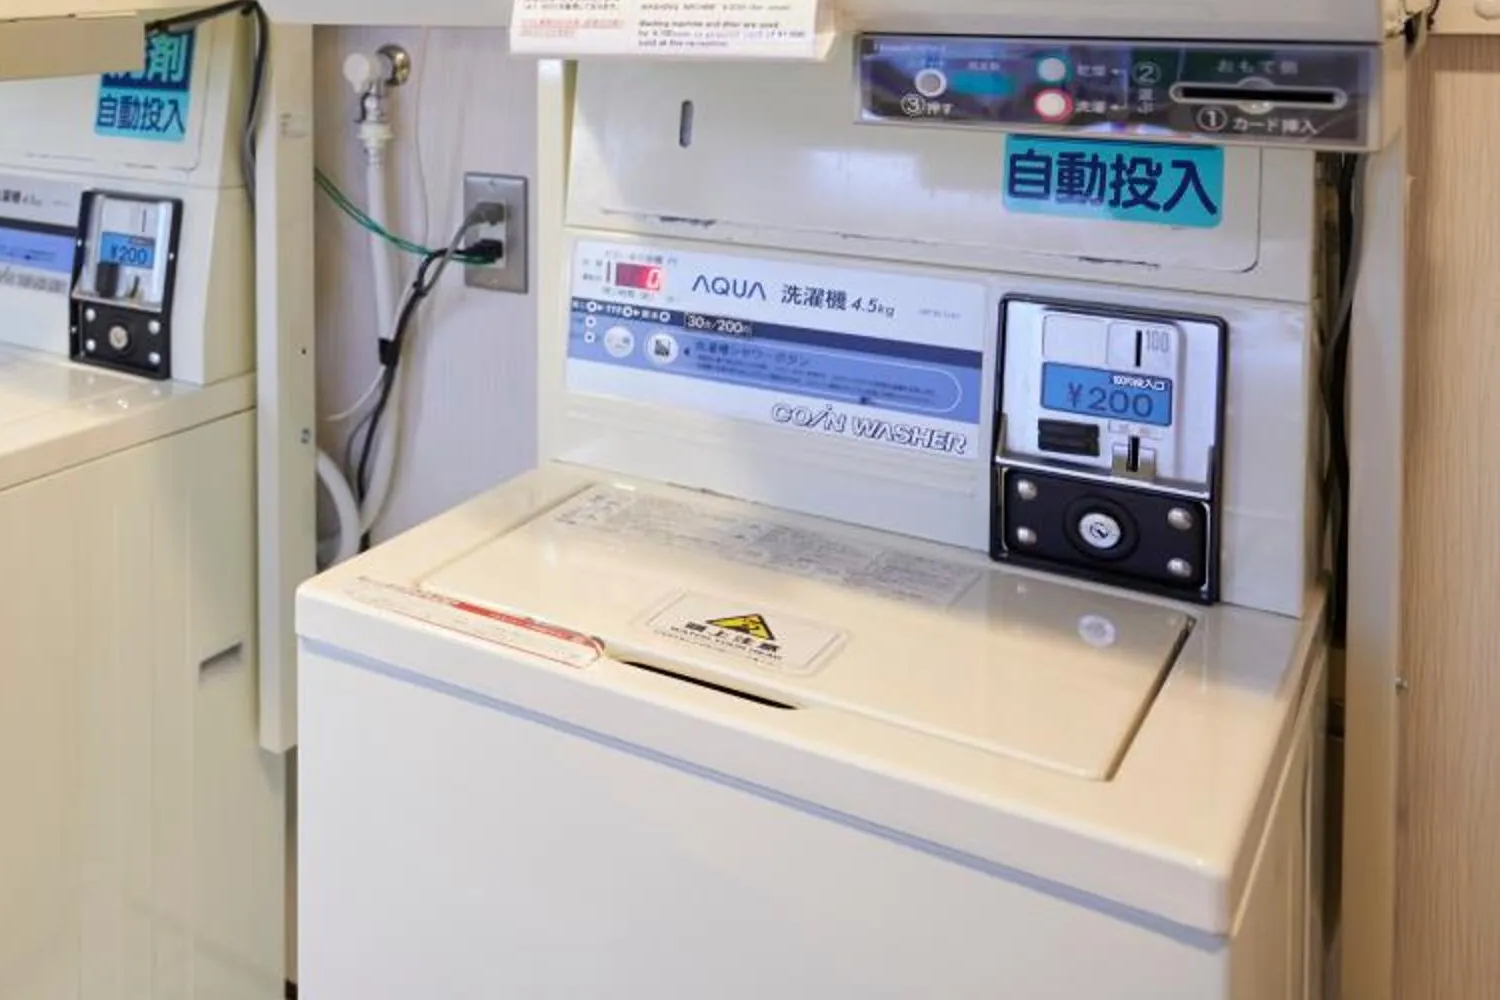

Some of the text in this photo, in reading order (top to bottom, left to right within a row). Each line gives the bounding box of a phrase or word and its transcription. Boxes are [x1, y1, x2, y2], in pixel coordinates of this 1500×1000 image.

[97, 95, 187, 135] 自動投入
[1007, 147, 1218, 216] 自動投入
[110, 243, 148, 264] ¥200
[647, 267, 662, 289] 0
[691, 274, 767, 301] AQUA
[780, 283, 848, 312] 洗濯機
[850, 297, 895, 319] 4.5kg
[1068, 381, 1154, 418] ¥200
[771, 402, 967, 455] COIN WASHER
